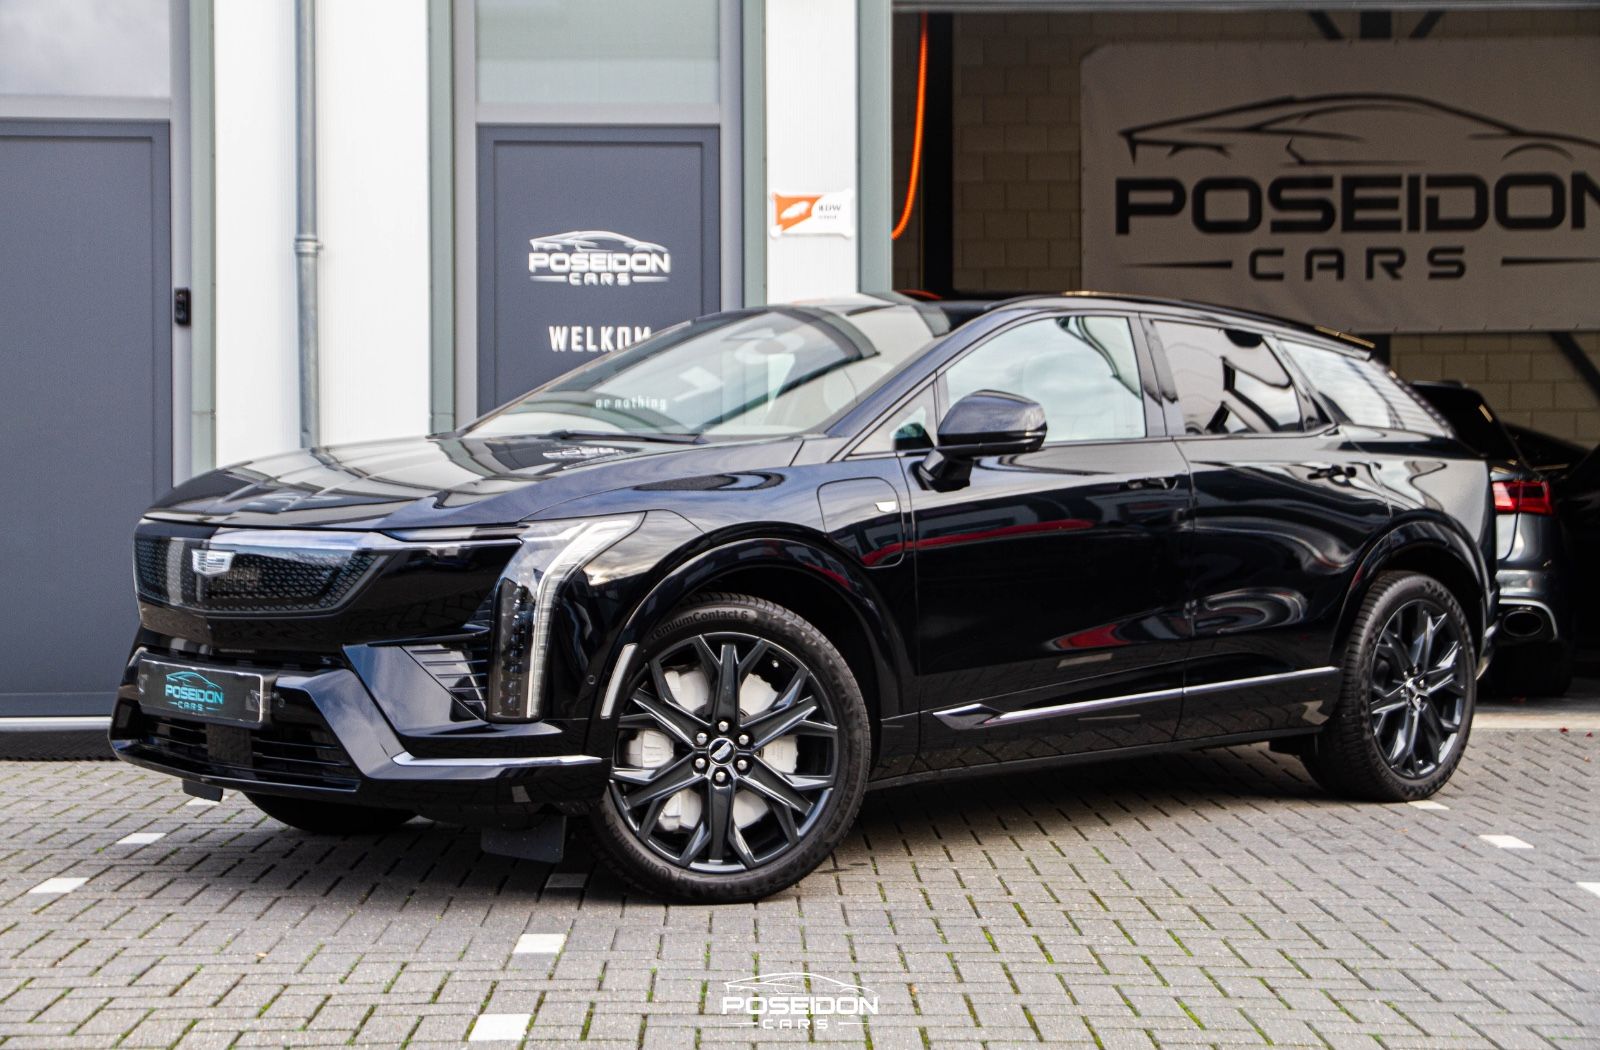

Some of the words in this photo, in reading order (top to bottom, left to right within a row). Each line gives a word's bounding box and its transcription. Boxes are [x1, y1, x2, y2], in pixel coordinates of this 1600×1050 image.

[528, 252, 671, 273] POSEIDON
[1248, 246, 1466, 281] CARS
[568, 272, 631, 286] CARS
[548, 325, 652, 352] WELKOM
[595, 399, 610, 409] or
[614, 396, 667, 413] nothing
[651, 609, 738, 640] remiumContact
[165, 684, 224, 704] POSEIDON
[177, 701, 204, 711] CARS
